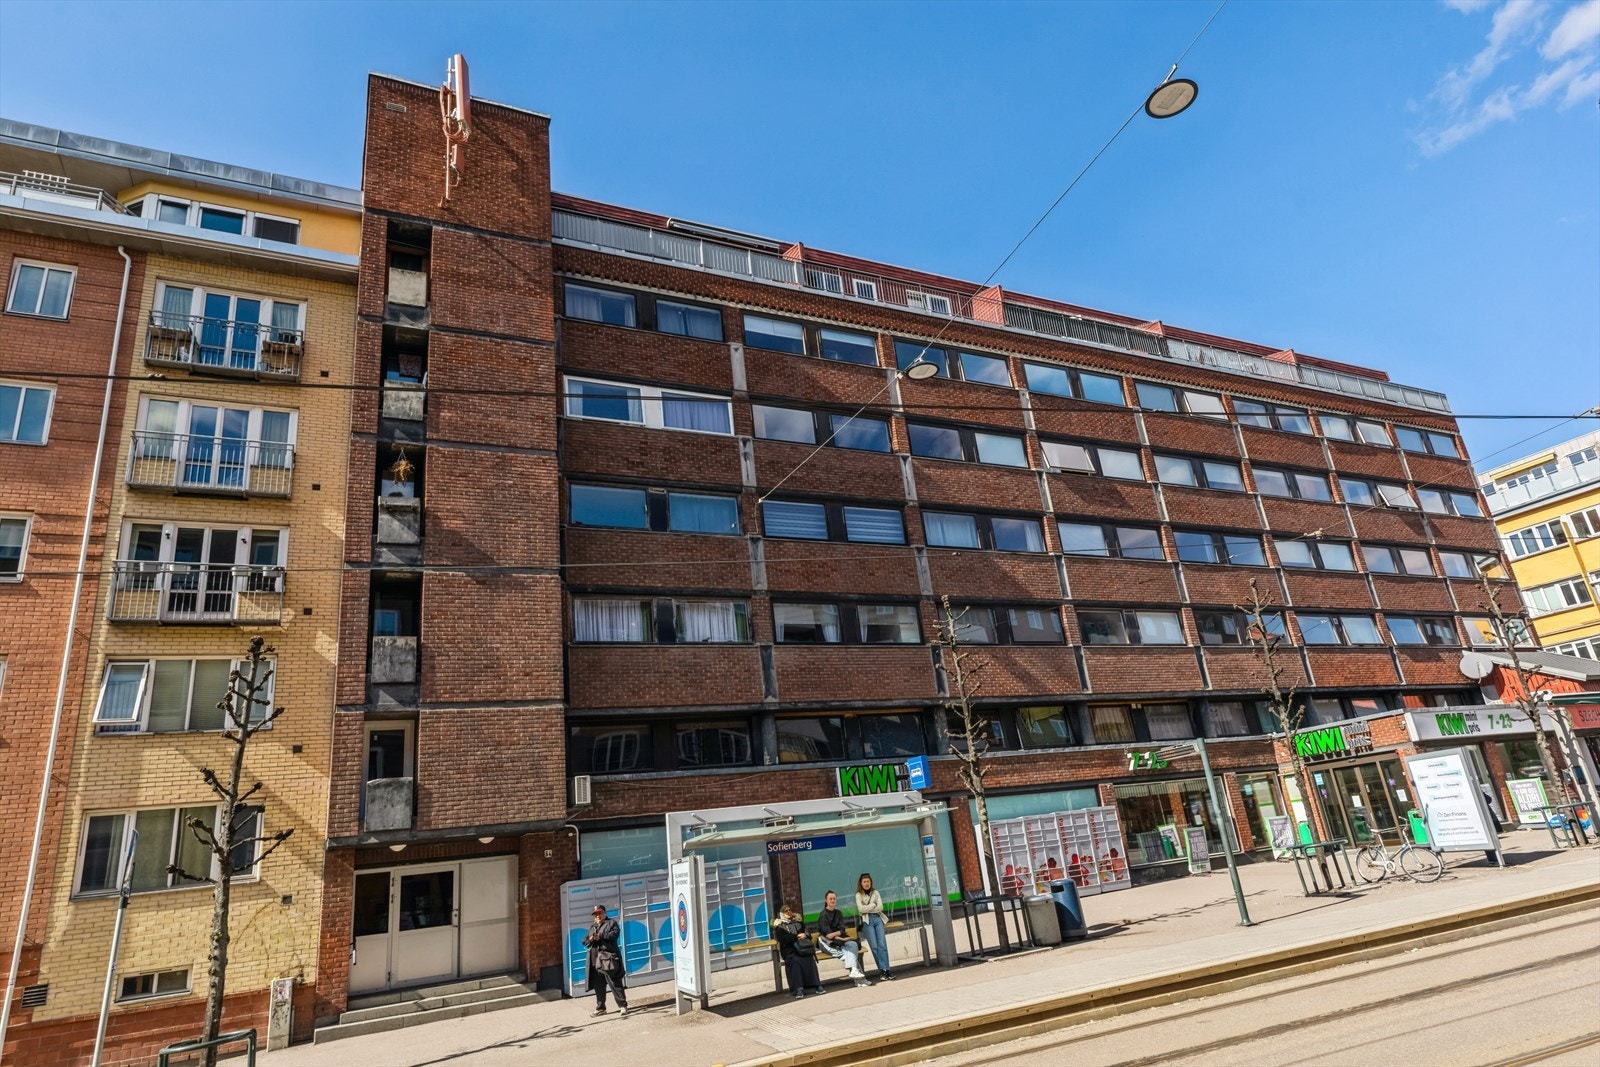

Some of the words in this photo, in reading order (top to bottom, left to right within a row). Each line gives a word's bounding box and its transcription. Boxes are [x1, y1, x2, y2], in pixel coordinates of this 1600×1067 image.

[1435, 713, 1470, 736] KIWI
[1465, 711, 1478, 721] mini
[1468, 722, 1480, 734] pris
[1294, 726, 1345, 757] KIWI
[838, 764, 898, 797] KIWI
[767, 840, 813, 853] Sofienberg
